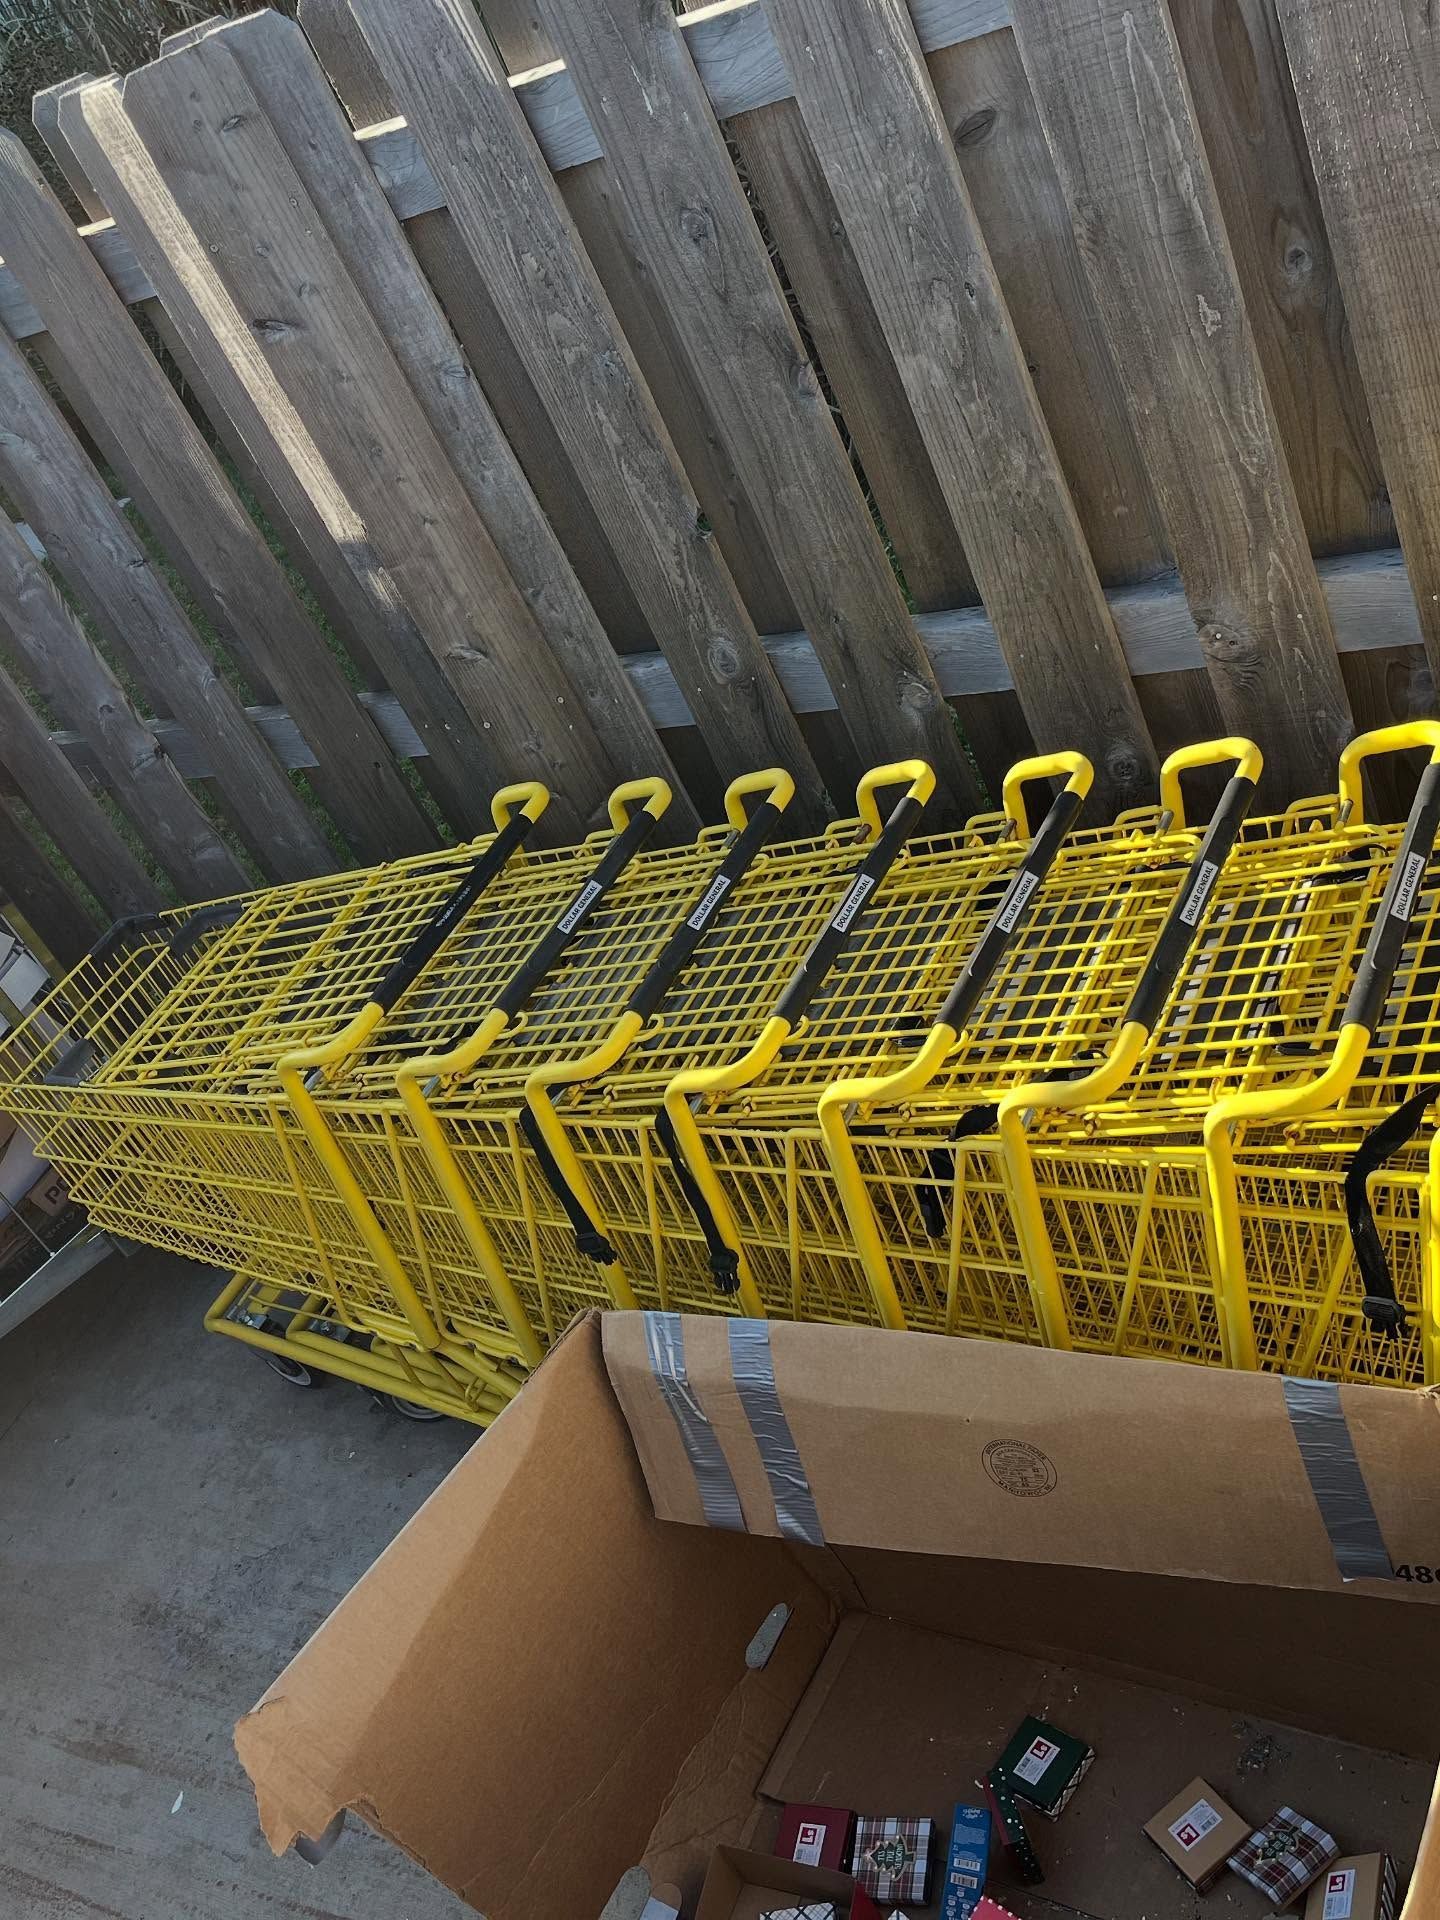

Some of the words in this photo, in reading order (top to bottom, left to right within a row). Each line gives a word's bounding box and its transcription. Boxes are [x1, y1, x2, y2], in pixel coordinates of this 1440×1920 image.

[561, 907, 581, 930] DOLLAR
[577, 885, 598, 909] GENERAL
[692, 904, 710, 926] DOLLAR
[707, 880, 727, 904] GENERAL
[836, 904, 855, 928] DOLLAR
[851, 879, 871, 905] GENERAL
[1001, 903, 1020, 928] DOLLAR
[1015, 877, 1034, 904] GENERAL
[1185, 894, 1201, 920] DOLLAR
[1197, 867, 1214, 894] GENERAL
[1396, 888, 1411, 916] DOLLAR
[1405, 858, 1421, 888] GENERAL
